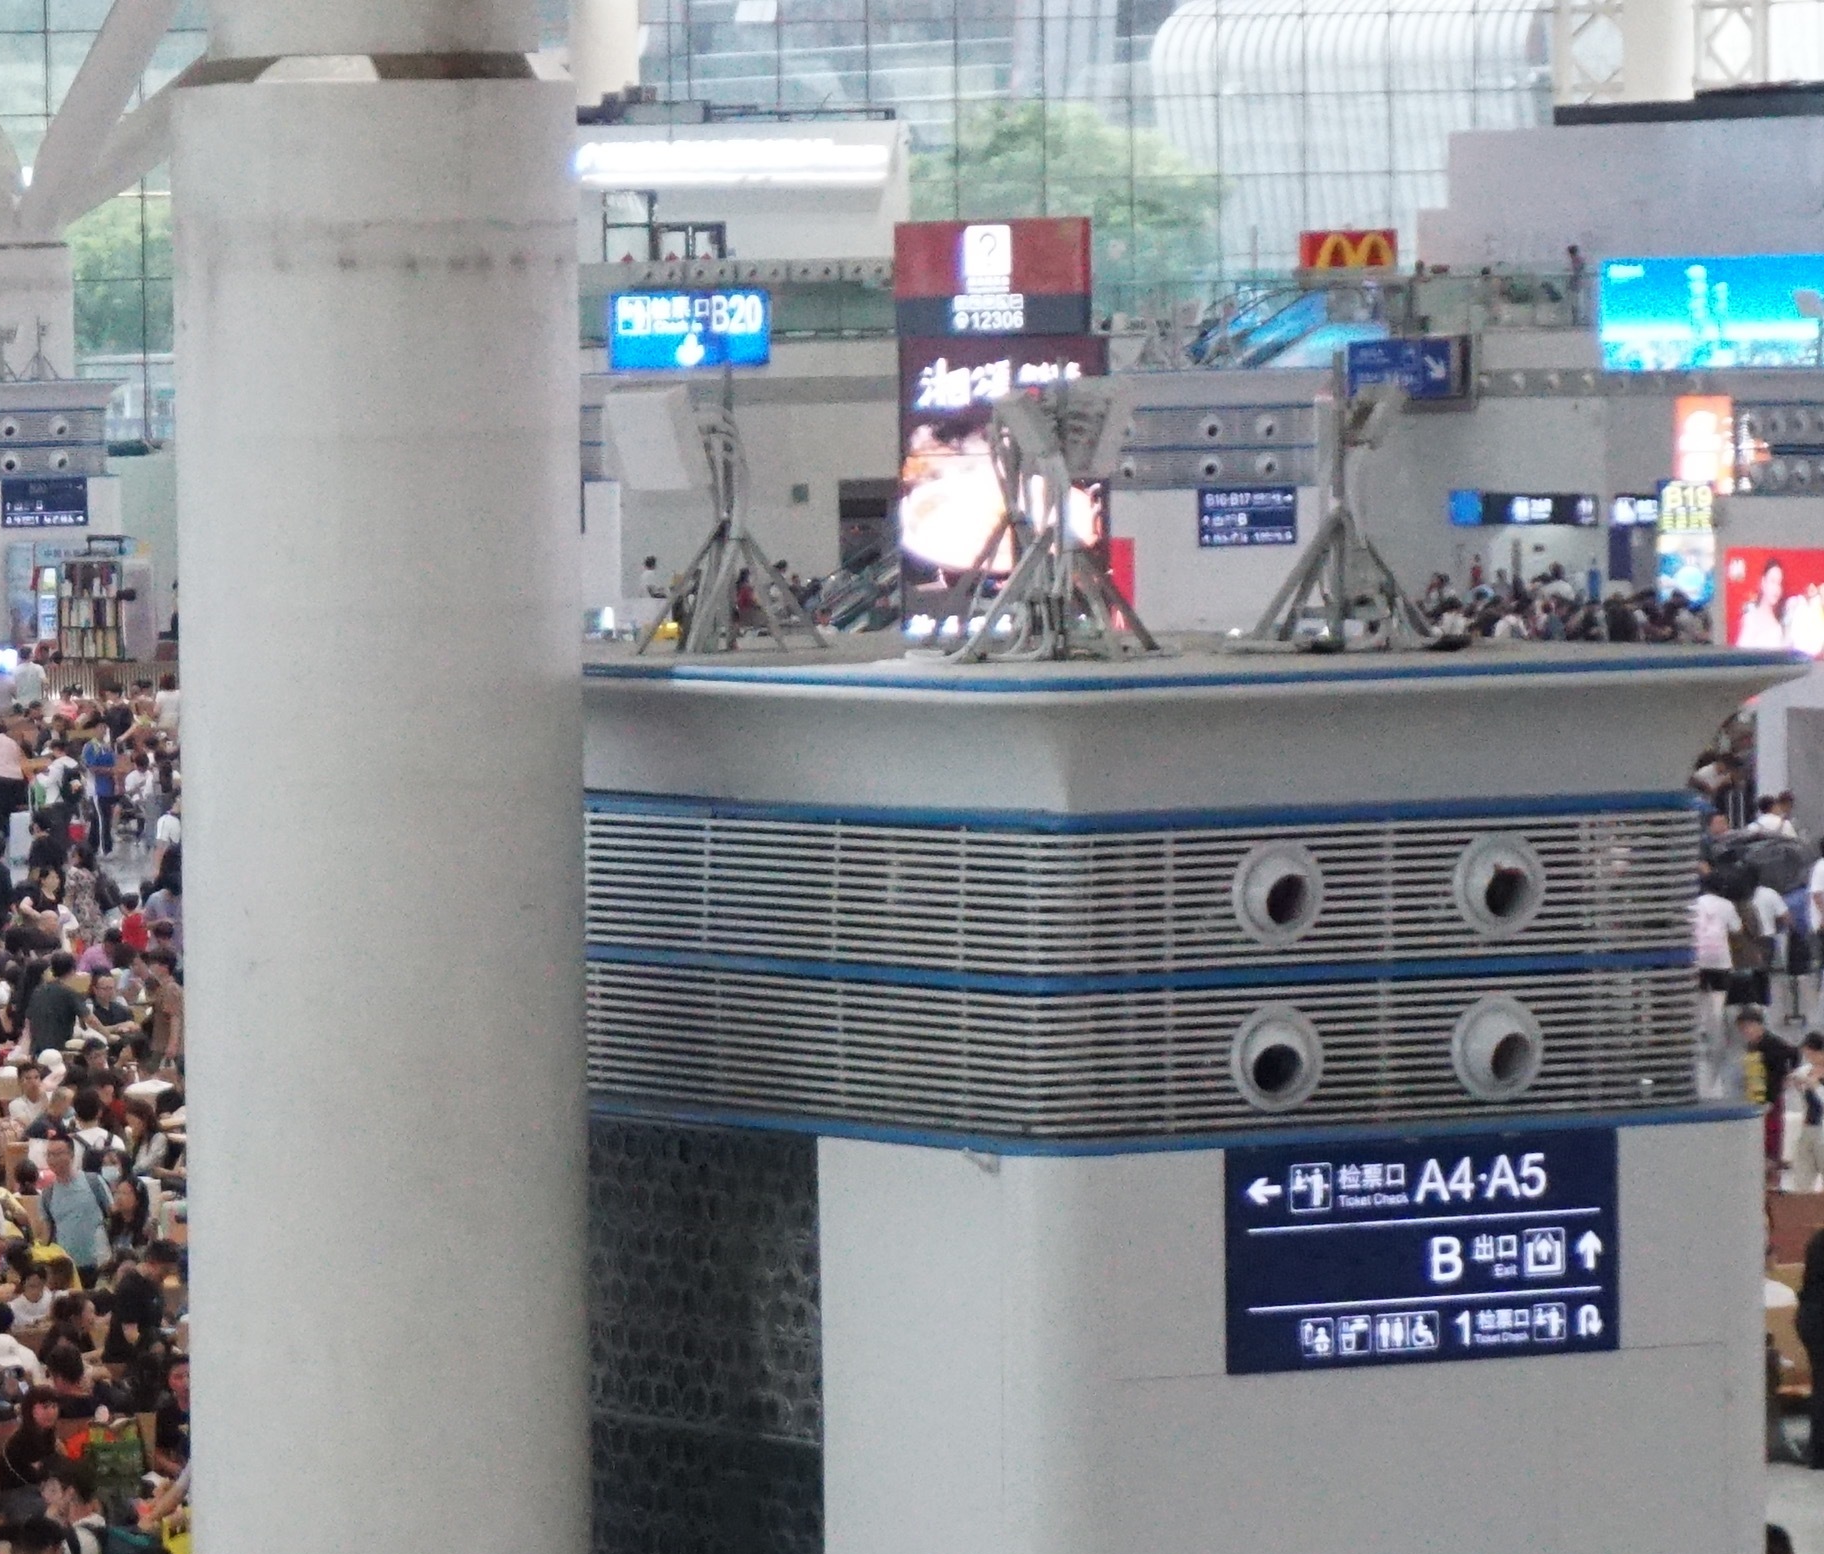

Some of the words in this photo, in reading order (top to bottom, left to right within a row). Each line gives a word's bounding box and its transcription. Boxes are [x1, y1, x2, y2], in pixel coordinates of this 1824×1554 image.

[712, 294, 763, 333] B20
[970, 311, 1024, 329] 12306
[1662, 484, 1712, 508] B19
[1337, 1163, 1405, 1191] 检票口
[1414, 1153, 1548, 1204] A4·A5
[1339, 1194, 1373, 1208] Ticket
[1375, 1192, 1409, 1206] Check
[1430, 1235, 1464, 1283] B
[1472, 1234, 1518, 1261] 出口
[1494, 1263, 1518, 1278] Exit
[1456, 1310, 1472, 1347] 1
[1476, 1308, 1530, 1331] 检票口
